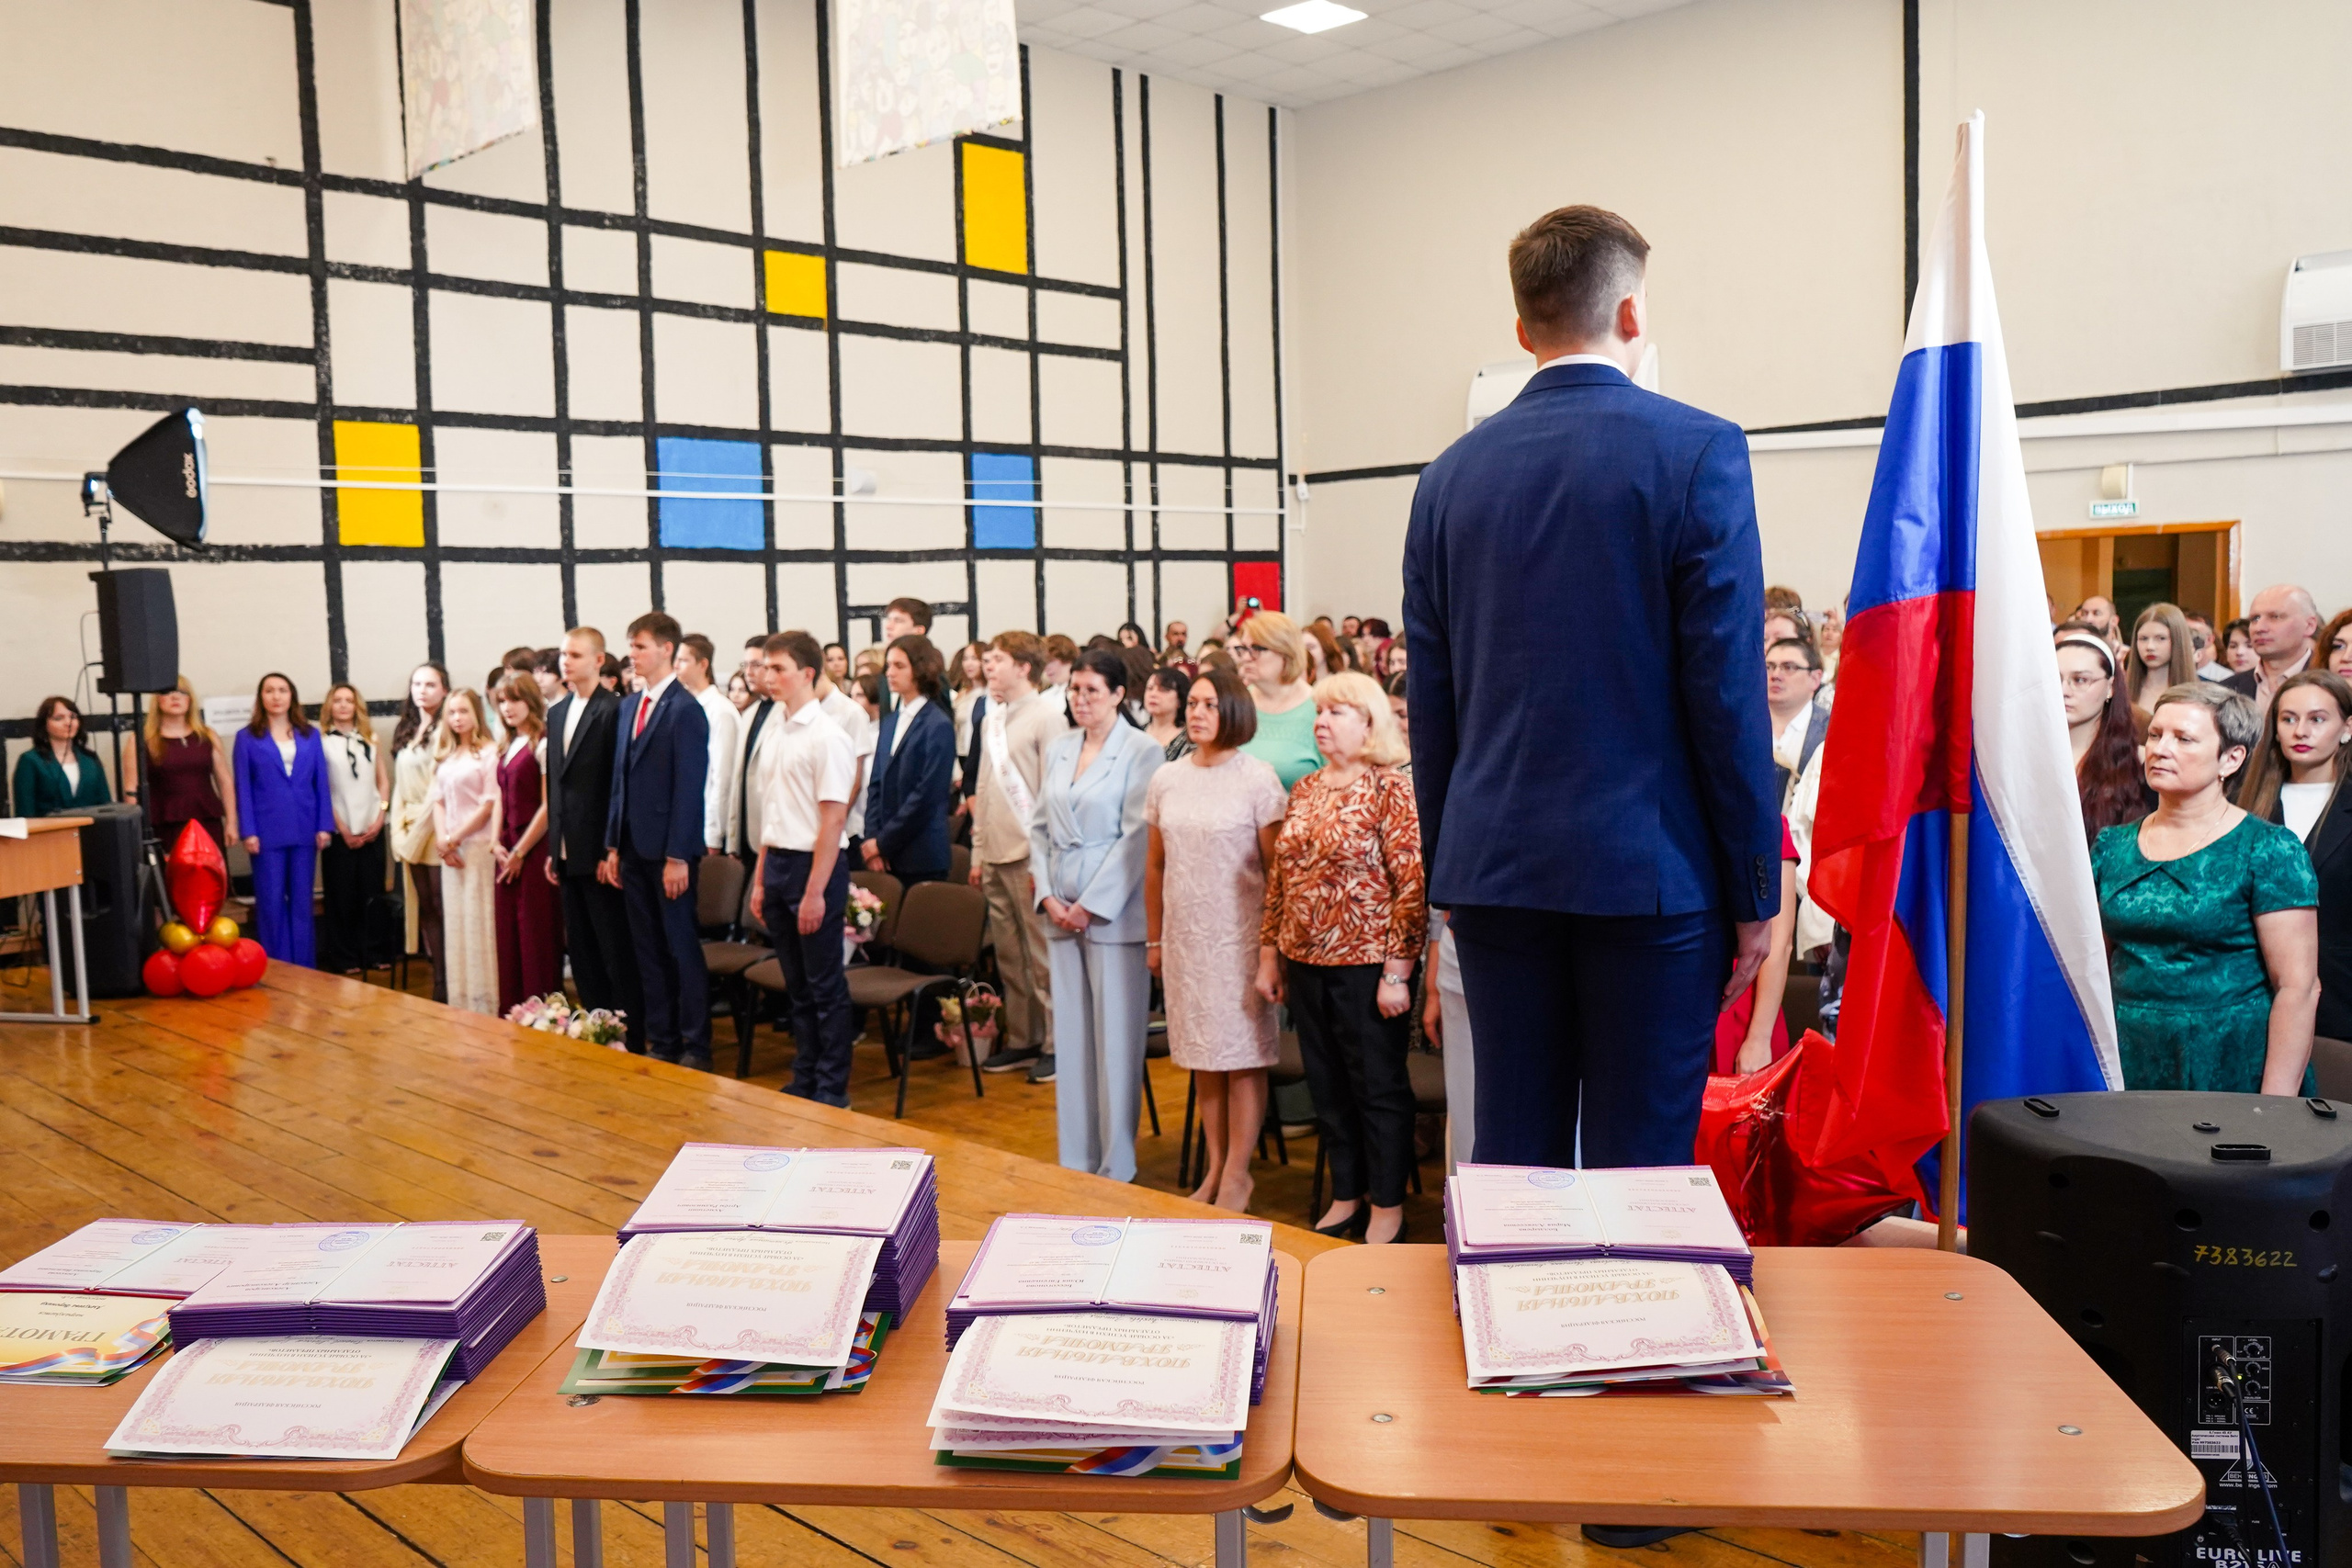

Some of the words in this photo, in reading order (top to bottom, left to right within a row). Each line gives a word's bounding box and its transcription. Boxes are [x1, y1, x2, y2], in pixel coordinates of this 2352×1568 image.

[1627, 1205, 1696, 1213] АТТЕСТАТ
[2194, 1245, 2297, 1267] 7383622
[1157, 1262, 1232, 1272] АТТЕСТАТ
[1517, 1289, 1680, 1312] ПОХВАЛЬНАЯ
[0, 1327, 106, 1343] ГРАМОТ
[1015, 1346, 1192, 1369] ПОХВАЛЬНАЯ
